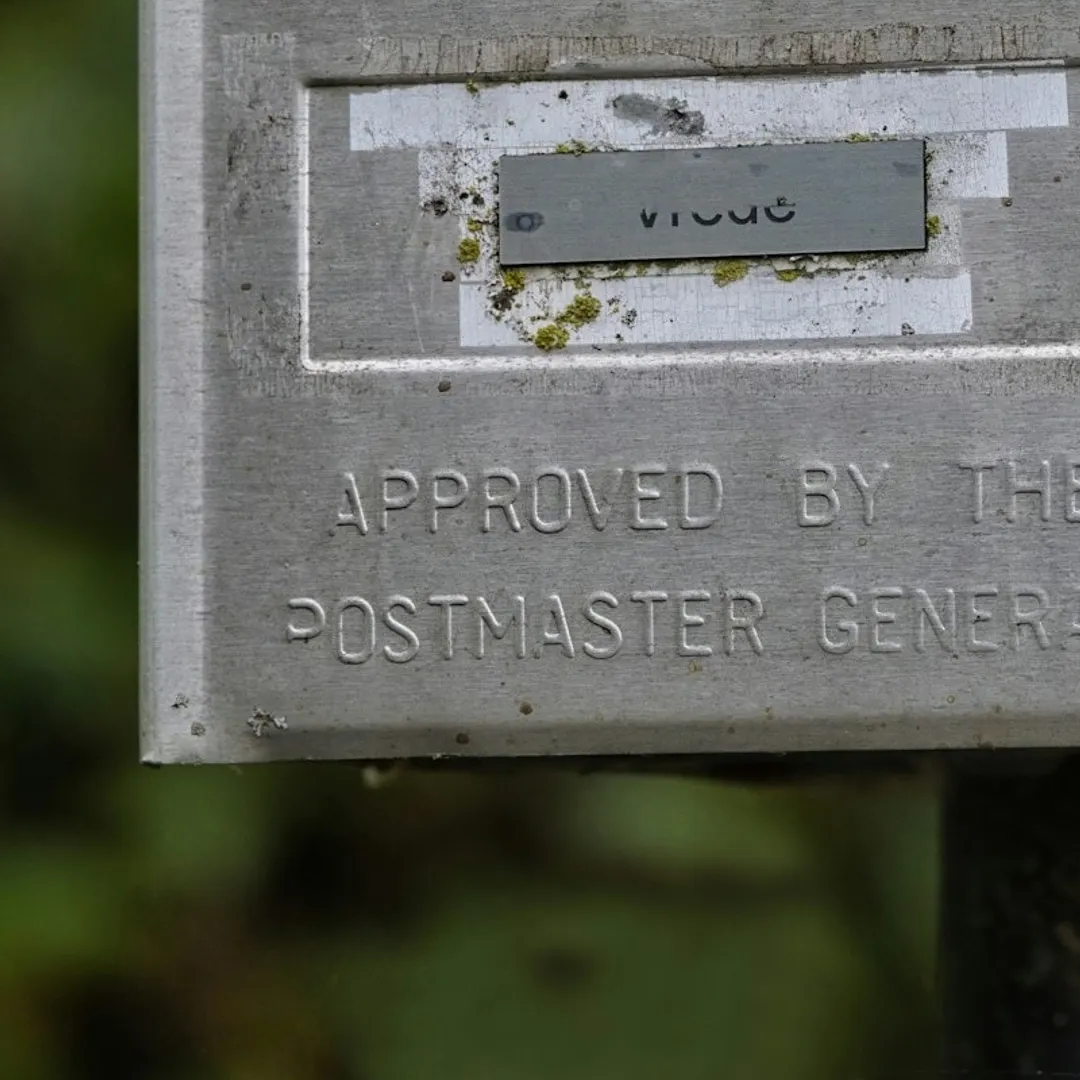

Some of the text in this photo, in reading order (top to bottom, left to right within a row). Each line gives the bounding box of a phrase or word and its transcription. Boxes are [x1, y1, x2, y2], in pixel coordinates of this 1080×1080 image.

[329, 461, 724, 536] APPROVED
[798, 459, 890, 528] BY
[286, 589, 765, 665] POSTMASTER
